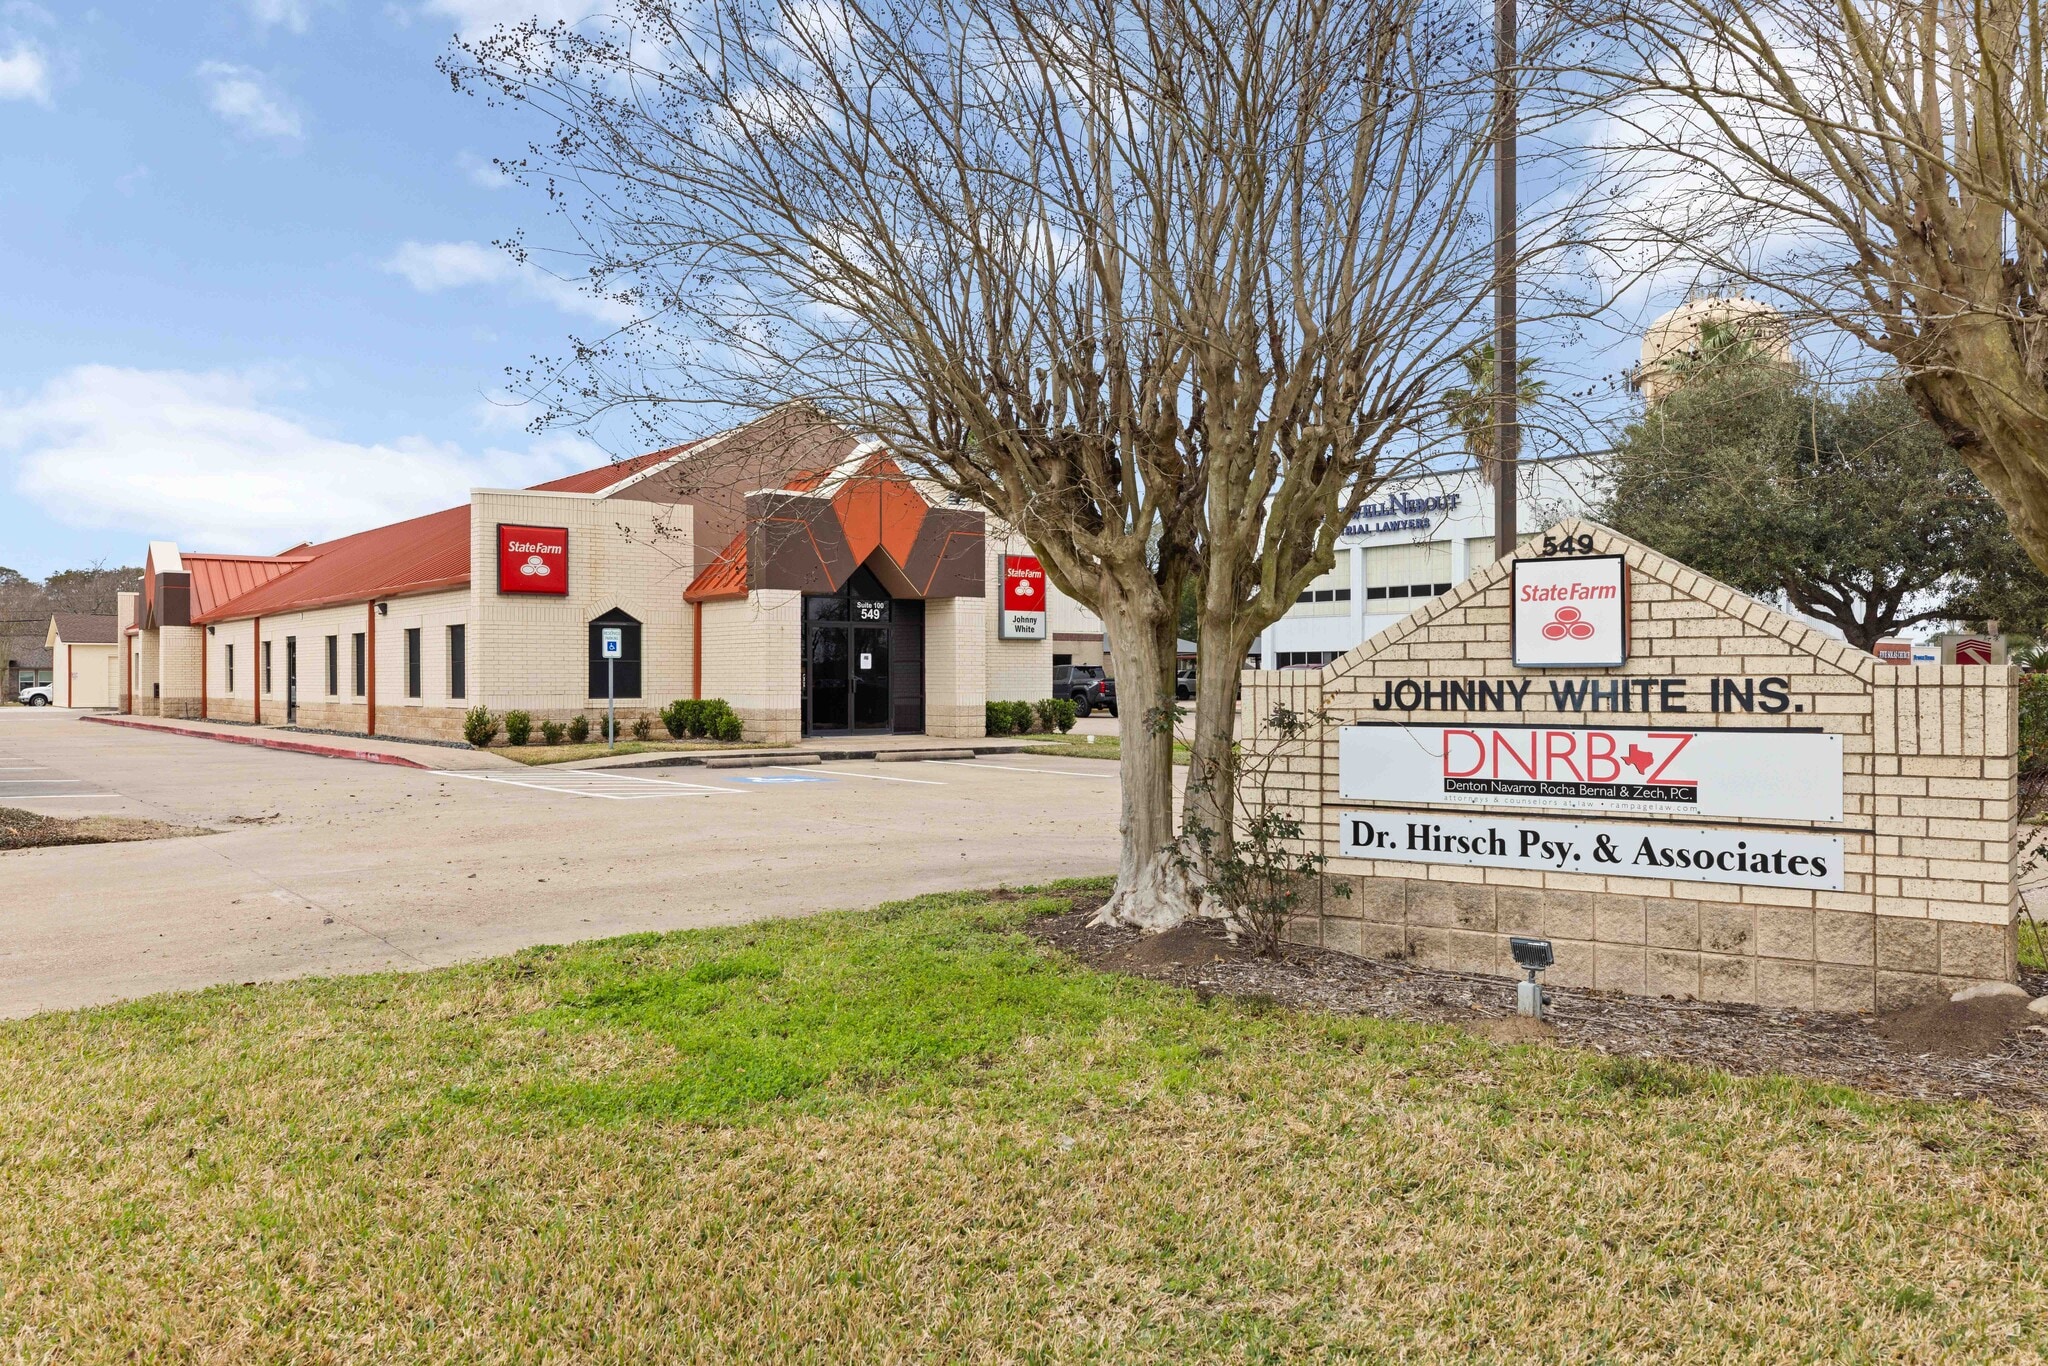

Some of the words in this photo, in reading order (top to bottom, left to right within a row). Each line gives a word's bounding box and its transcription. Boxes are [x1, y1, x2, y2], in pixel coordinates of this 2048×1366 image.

[1376, 518, 1431, 532] LAWYERS
[1543, 534, 1594, 556] 549
[861, 608, 880, 619] 549
[1012, 615, 1038, 625] Johnny
[1014, 625, 1035, 633] White
[1373, 679, 1531, 711] JOHNNY
[1549, 678, 1687, 713] WHITE
[1710, 677, 1802, 714] INS.
[1446, 779, 1488, 792] Denton
[1491, 781, 1537, 793] Navarro
[1540, 782, 1576, 795] Rocha
[1579, 784, 1616, 797] Bernal
[1620, 785, 1629, 798] &
[1633, 786, 1668, 800] Zech,
[1670, 788, 1693, 800] P.C.
[1443, 795, 1489, 804] attorneys
[1504, 797, 1558, 806] counselors
[1610, 802, 1698, 812] rampagelaw.com
[1351, 820, 1396, 849] Dr.
[1406, 823, 1507, 857] Hirsch
[1518, 829, 1581, 868] Psy.
[1593, 833, 1622, 864] &
[1631, 836, 1828, 878] Associates
